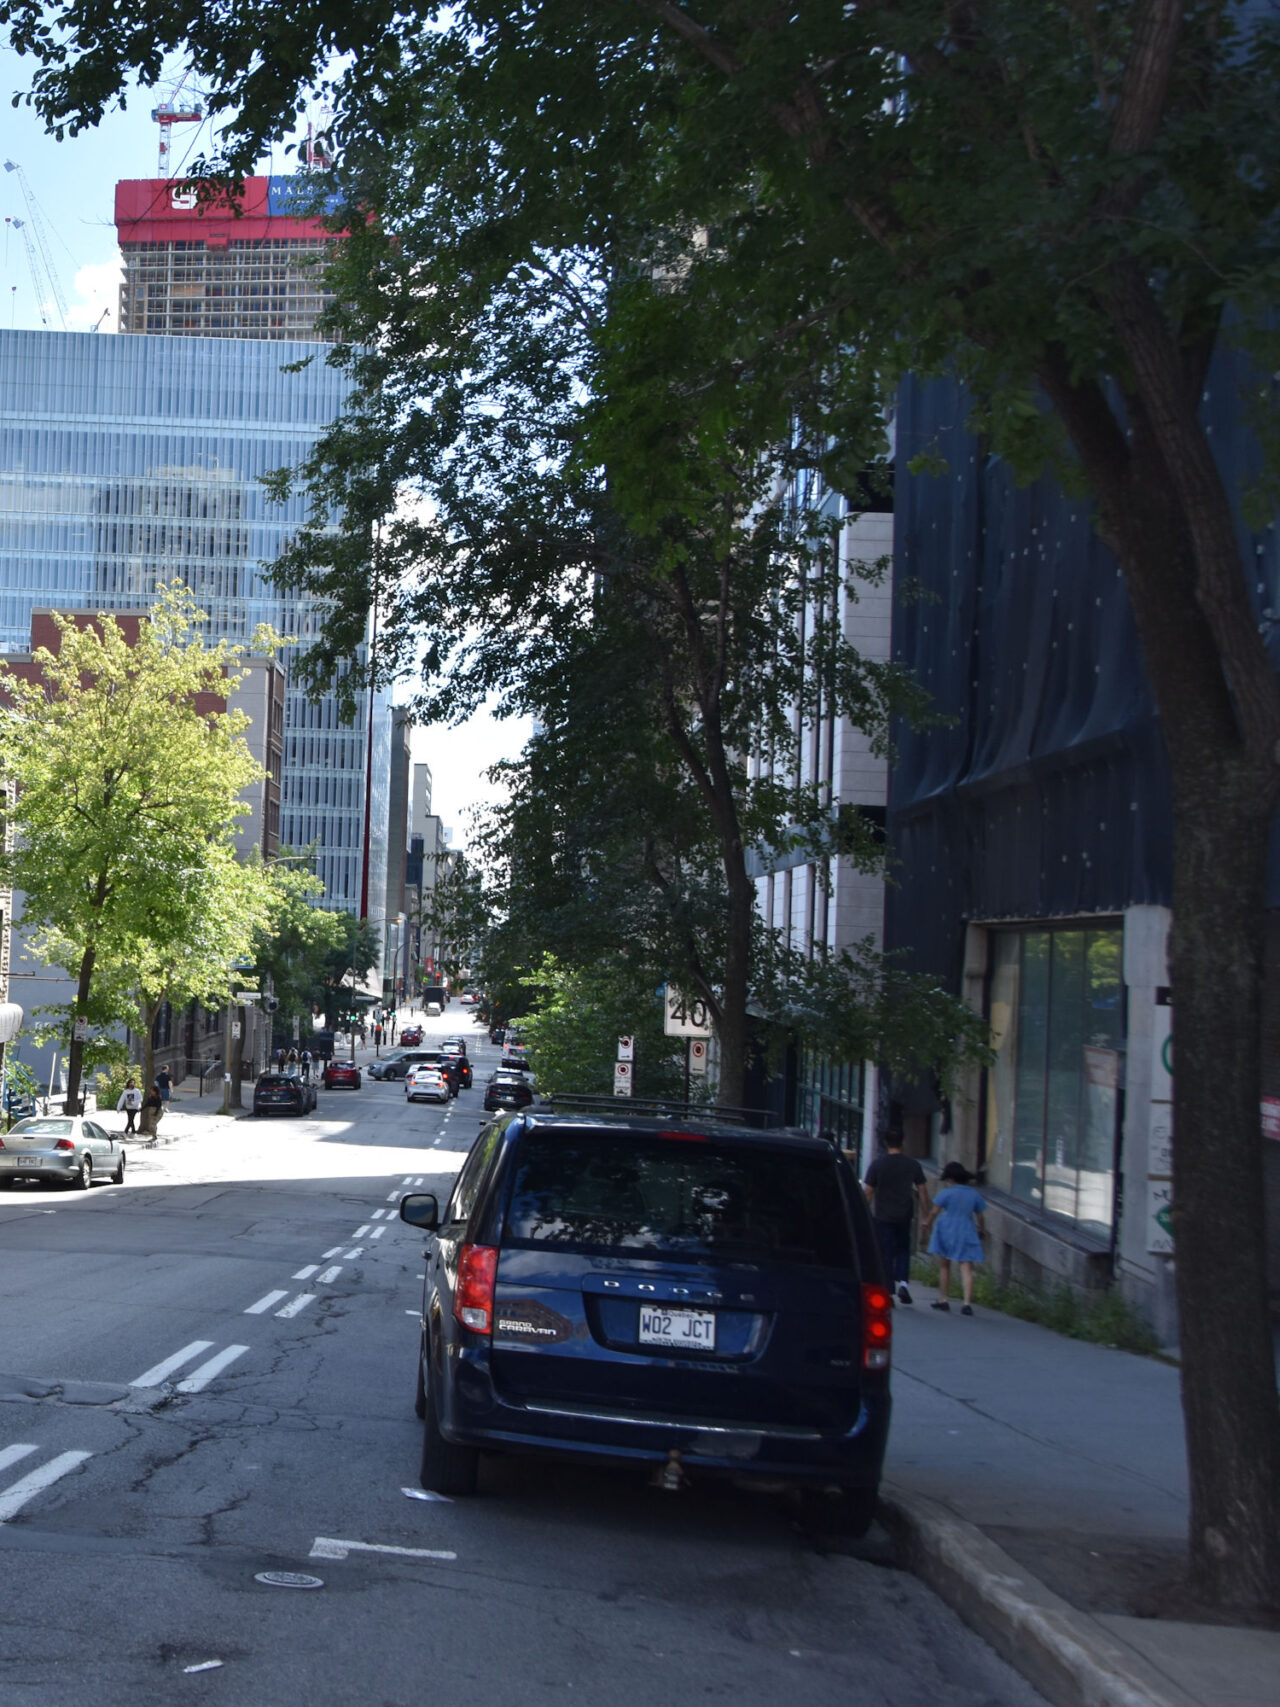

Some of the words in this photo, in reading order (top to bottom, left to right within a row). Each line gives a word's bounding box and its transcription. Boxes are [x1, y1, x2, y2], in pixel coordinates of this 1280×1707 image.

[670, 998, 707, 1028] 40
[642, 1314, 672, 1336] W02
[682, 1318, 713, 1340] JCT
